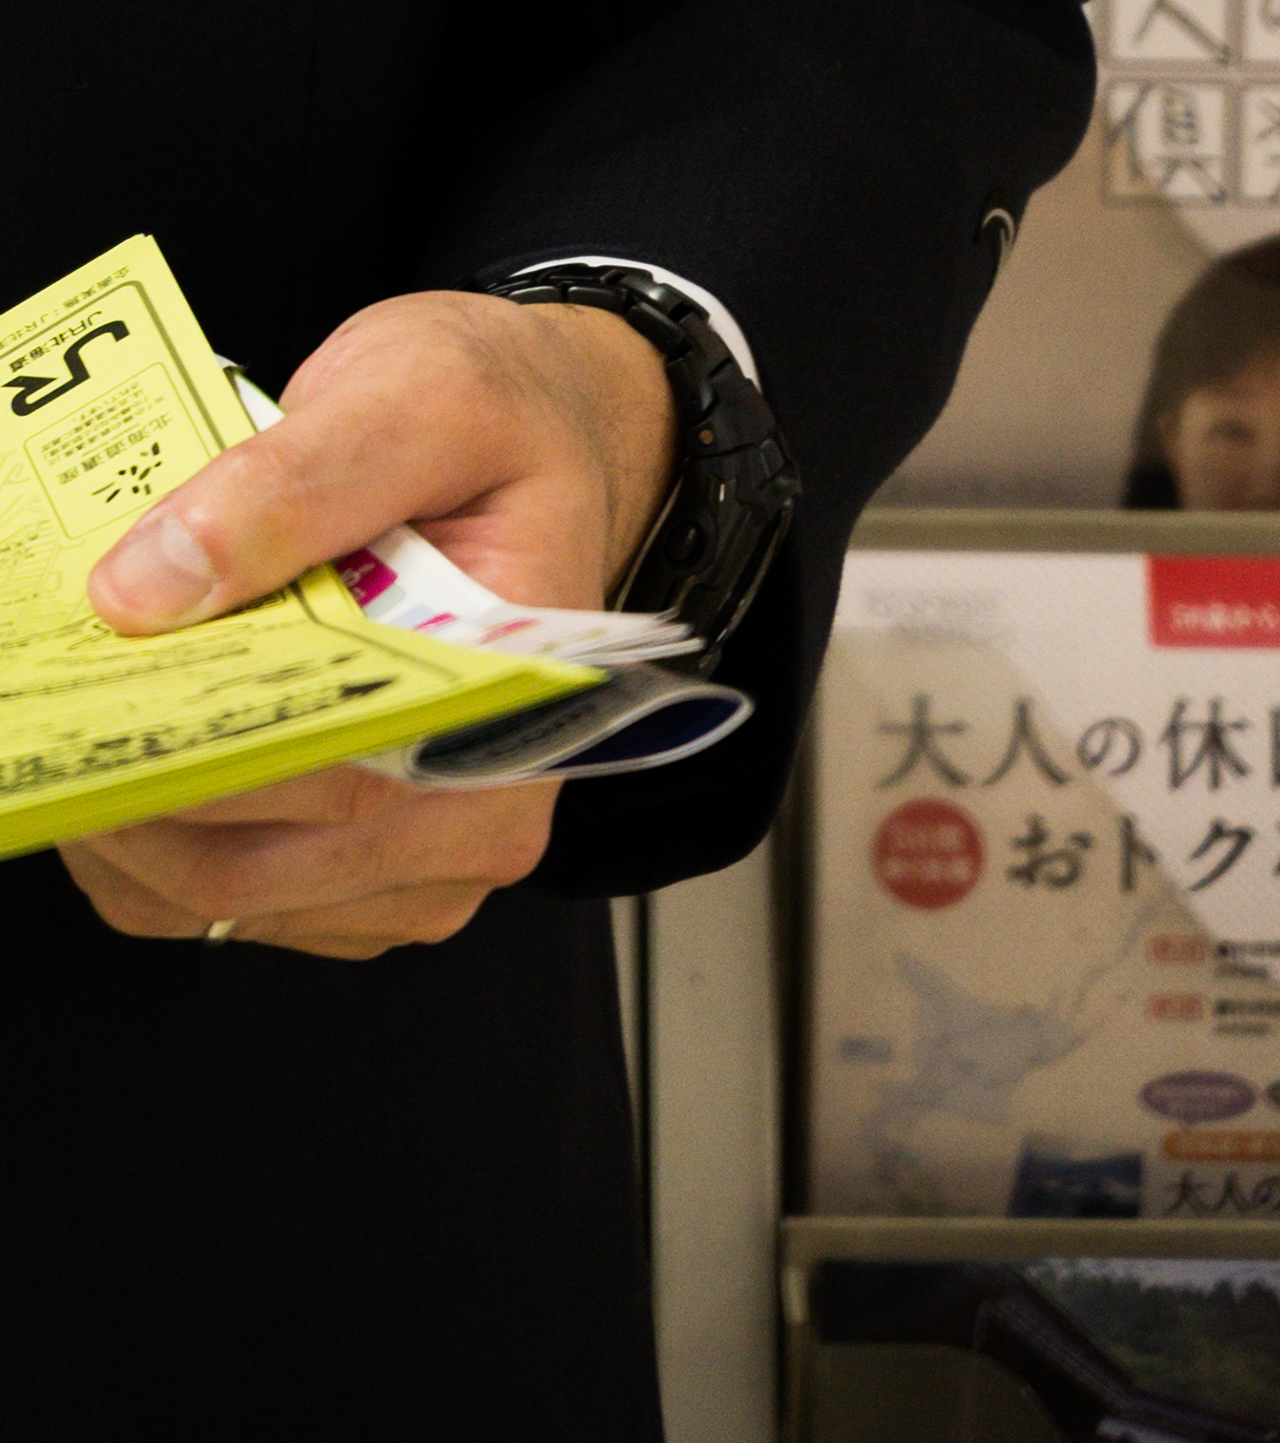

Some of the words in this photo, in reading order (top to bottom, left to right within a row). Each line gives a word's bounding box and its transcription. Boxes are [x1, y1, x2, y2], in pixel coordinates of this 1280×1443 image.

[0, 319, 131, 418] JR
[8, 310, 103, 374] JR北海道
[56, 411, 174, 485] 北海道遺産
[874, 692, 1280, 792] 大人の休
[1005, 812, 1280, 895] おトク
